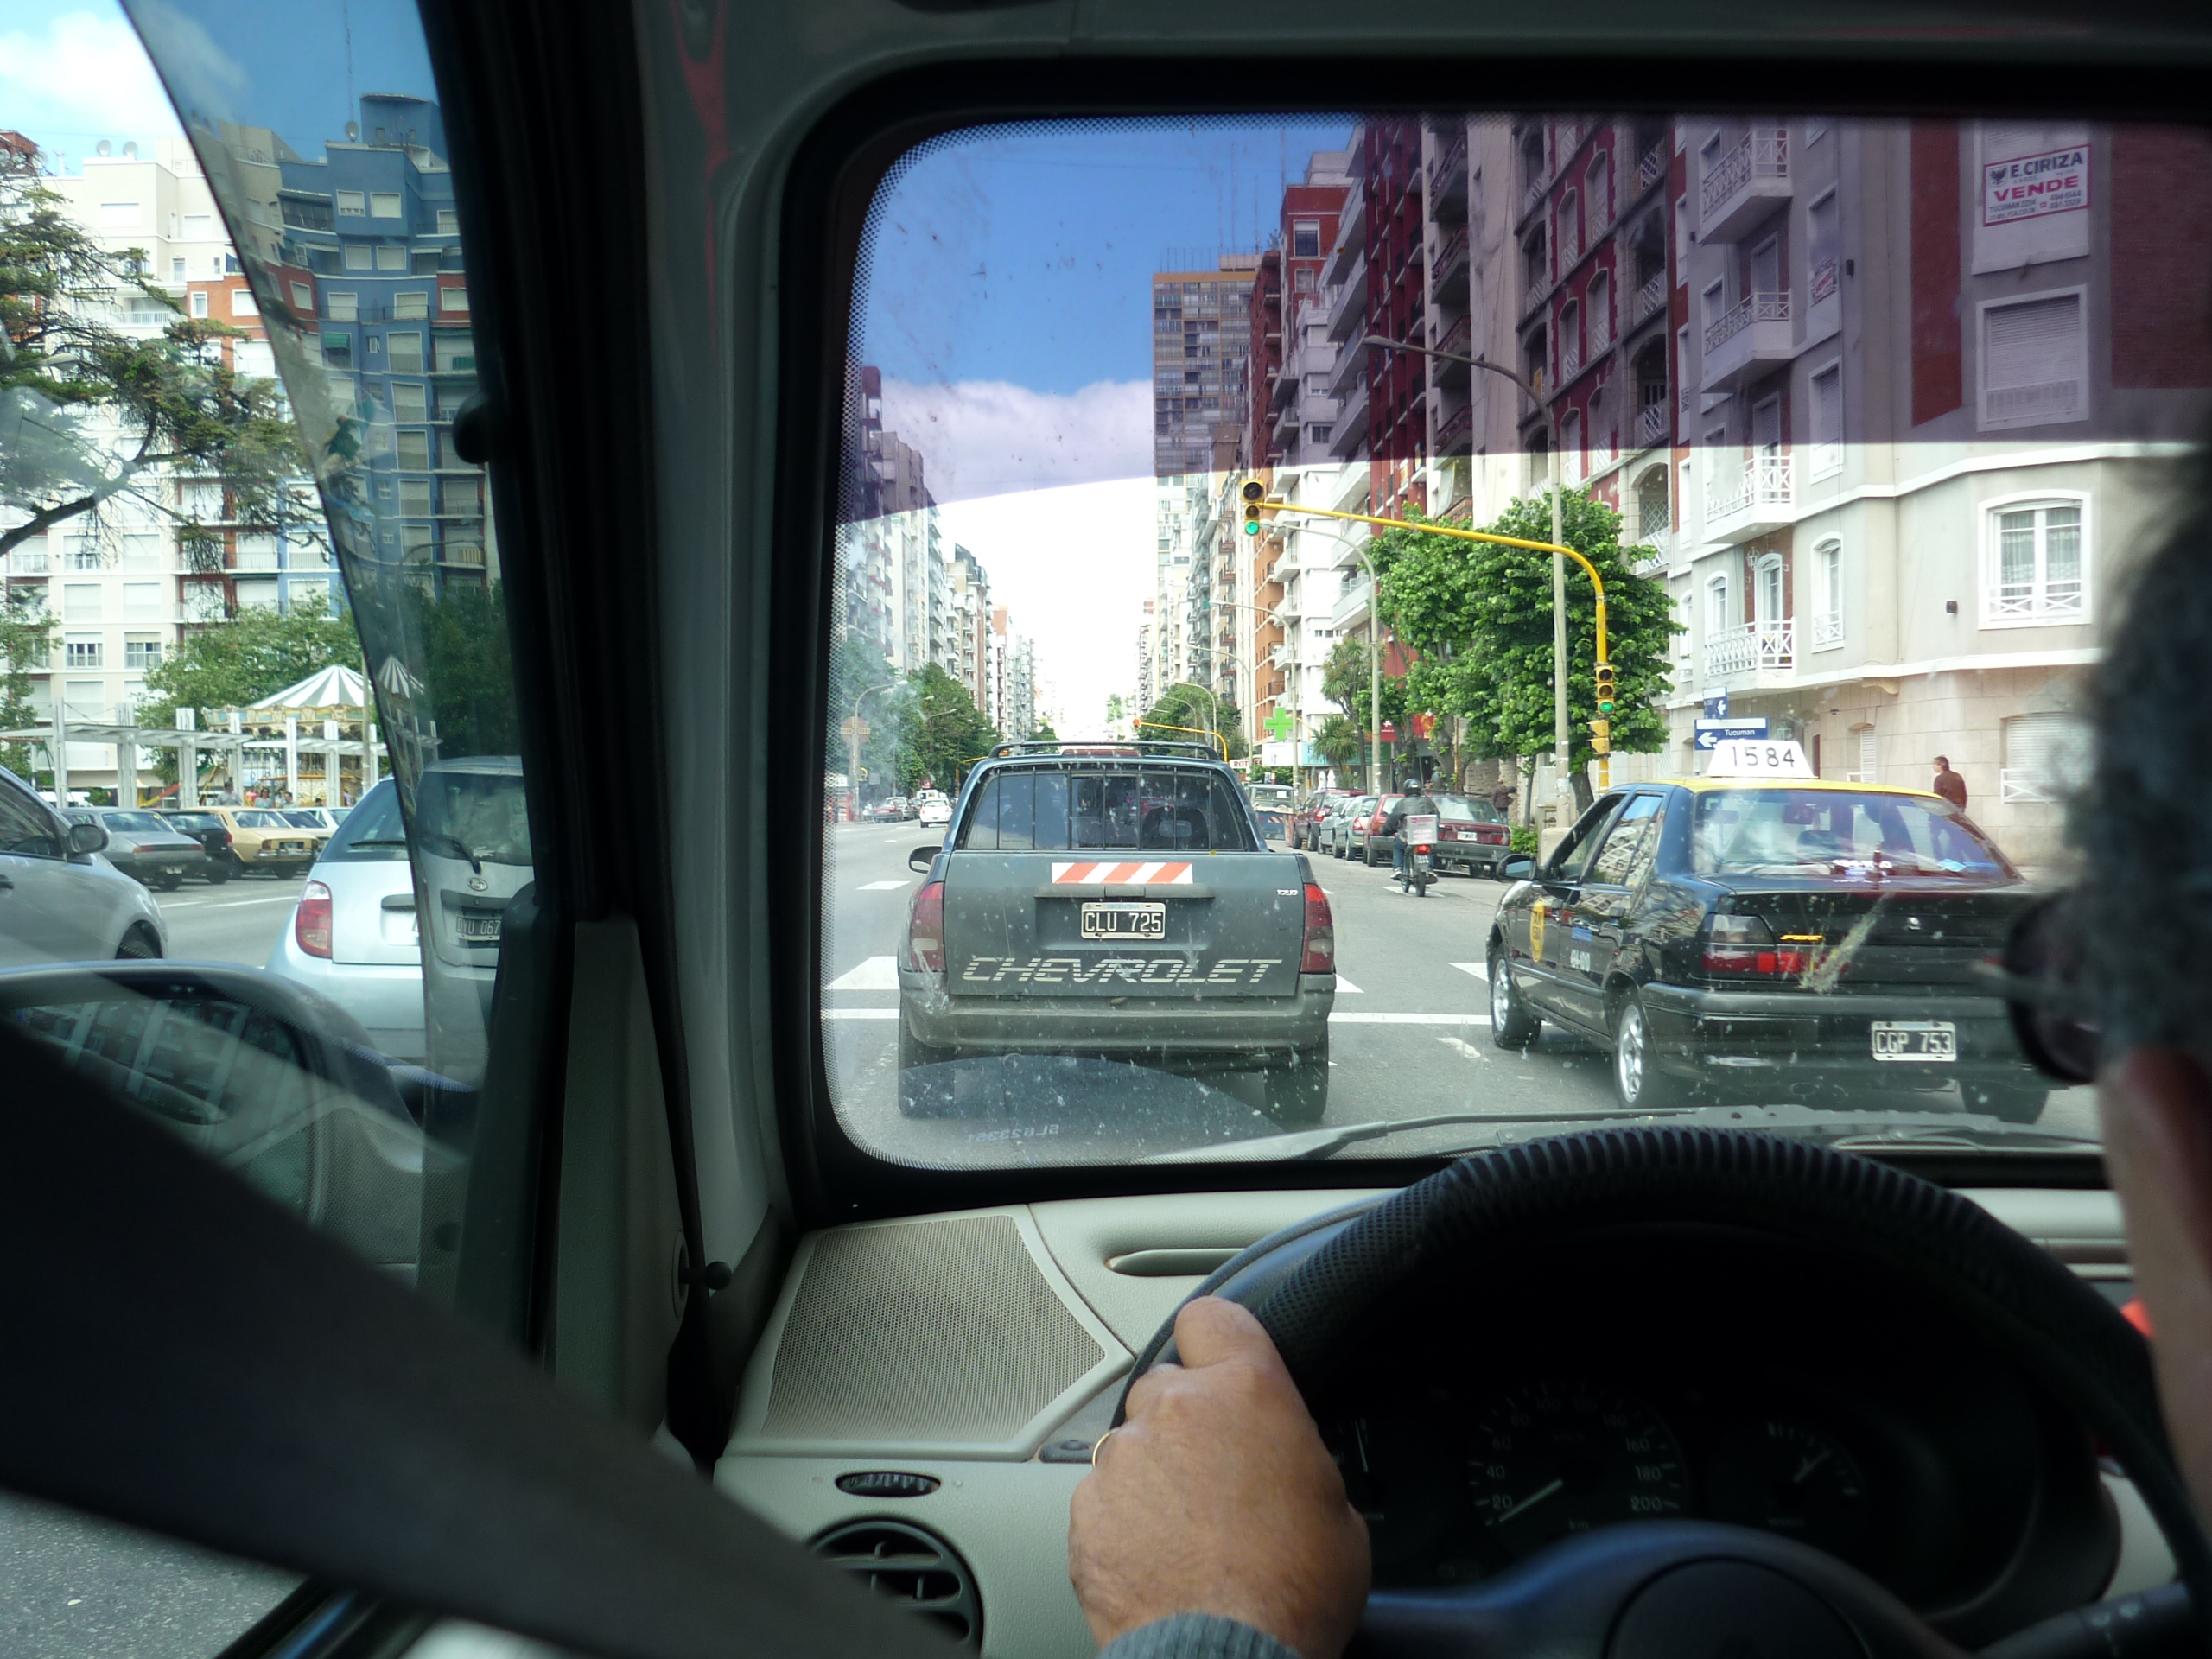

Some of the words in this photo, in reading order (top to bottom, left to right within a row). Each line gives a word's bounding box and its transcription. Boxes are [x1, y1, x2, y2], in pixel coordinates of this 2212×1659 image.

[1993, 175, 2079, 202] VENDE
[1732, 746, 1795, 768] 1584
[480, 920, 501, 935] 067
[1085, 912, 1117, 931] CLU
[1128, 912, 1162, 932] 725
[963, 957, 1282, 982] CHEVROLET
[1877, 1032, 1909, 1052] CGP
[1918, 1032, 1953, 1053] 753
[1492, 1435, 1511, 1449] 60
[1486, 1465, 1505, 1478] 40
[1635, 1465, 1662, 1481] 180
[1492, 1495, 1512, 1510] 20
[1630, 1496, 1662, 1511] 200
